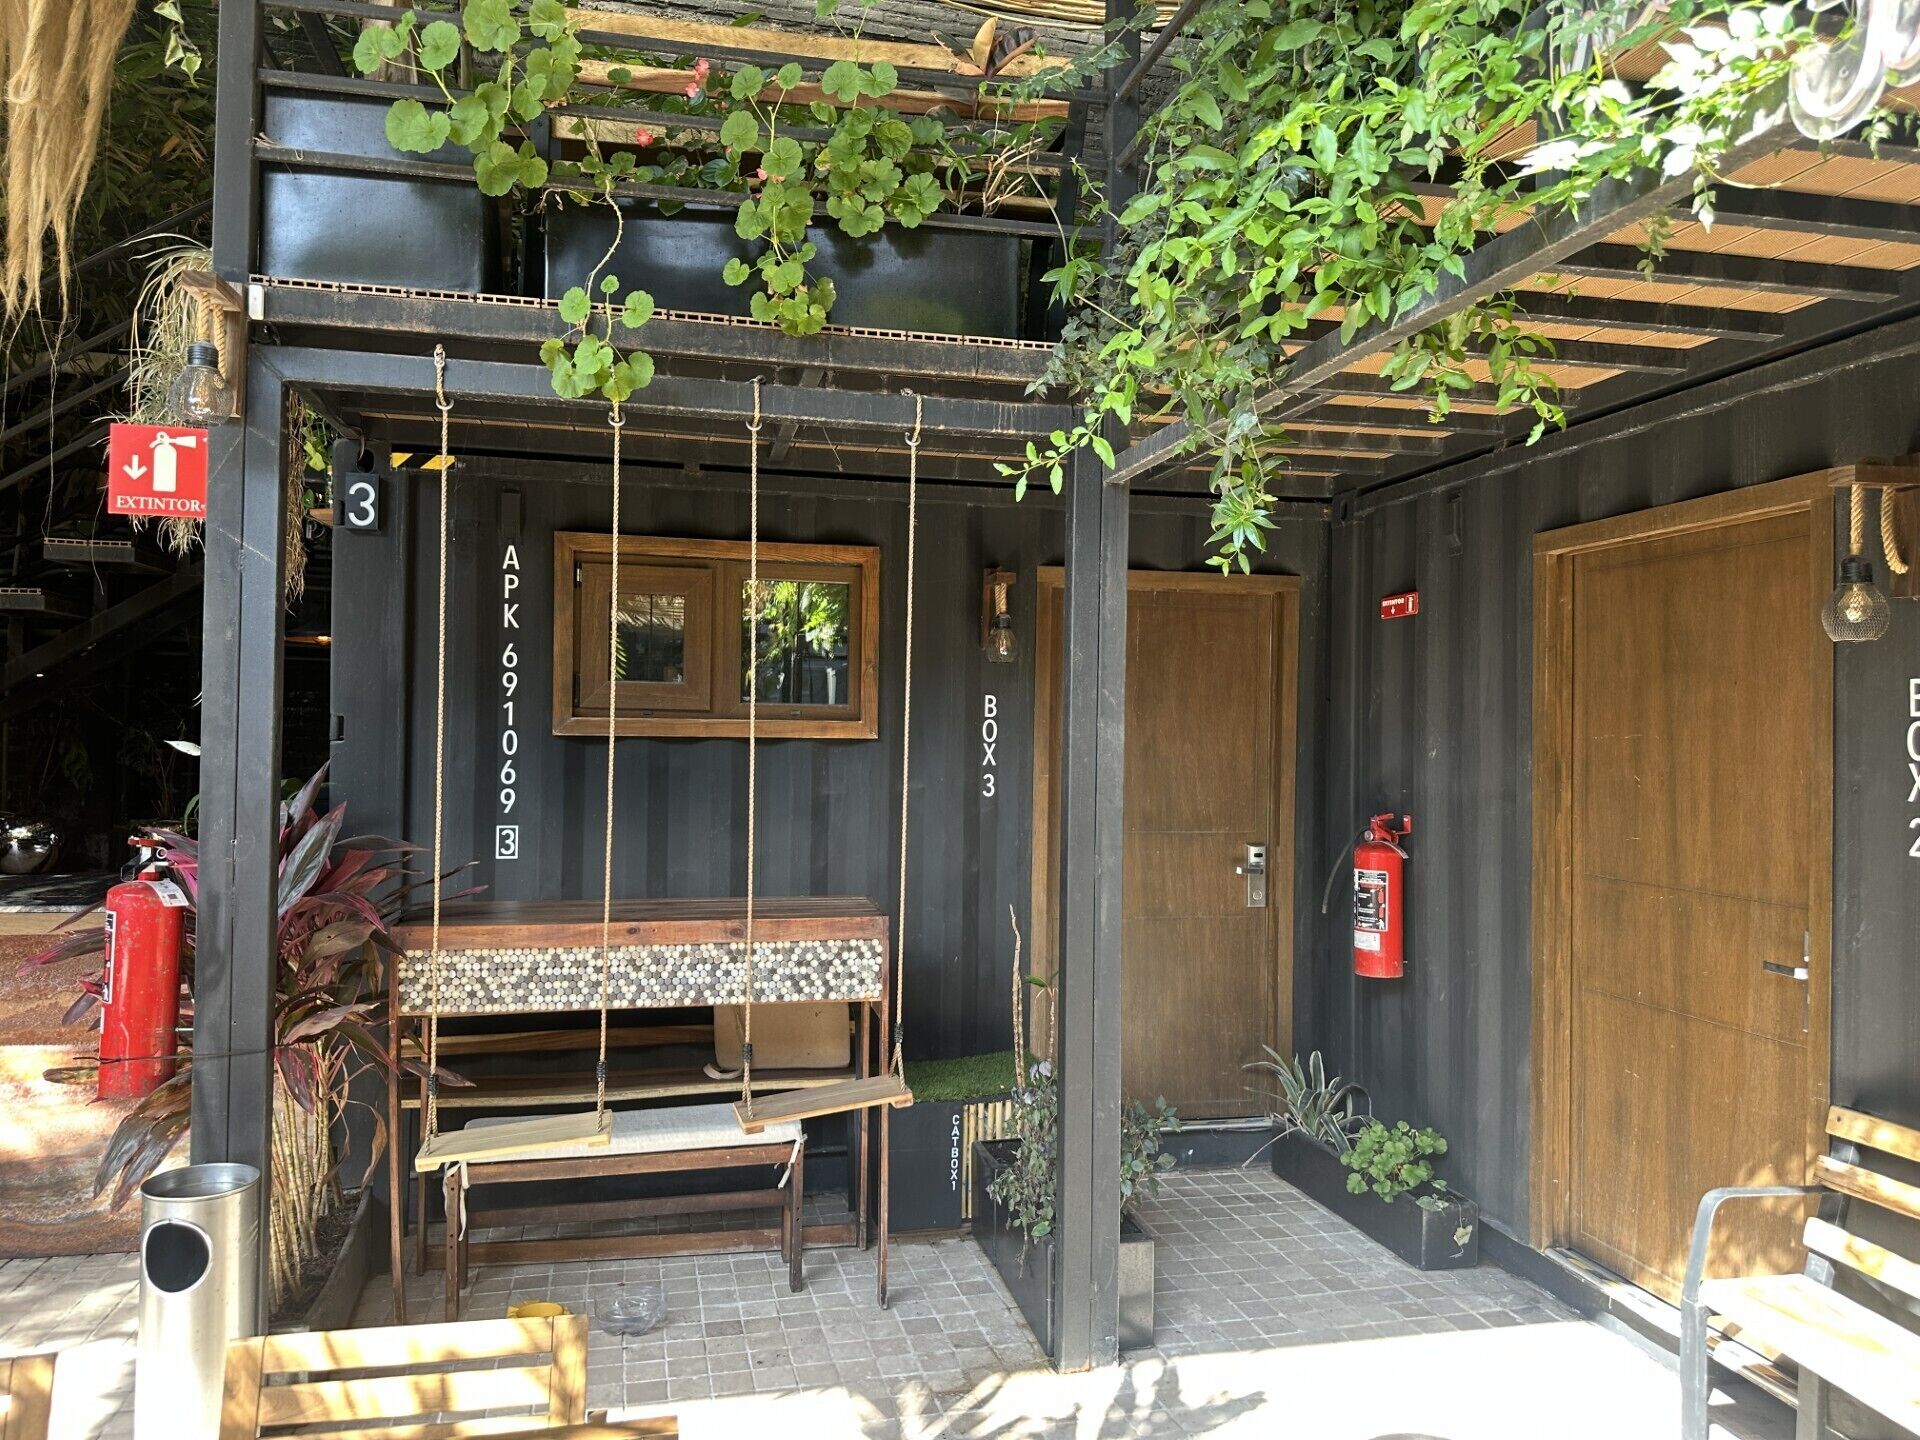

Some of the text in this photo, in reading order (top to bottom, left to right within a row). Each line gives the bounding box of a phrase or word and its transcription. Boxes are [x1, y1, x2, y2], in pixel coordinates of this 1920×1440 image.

[116, 495, 200, 512] EXTINTOR
[348, 481, 376, 527] 3
[500, 544, 520, 855] APK 691069 3
[982, 694, 998, 797] BOX 3
[950, 1114, 960, 1191] CATBOX1
